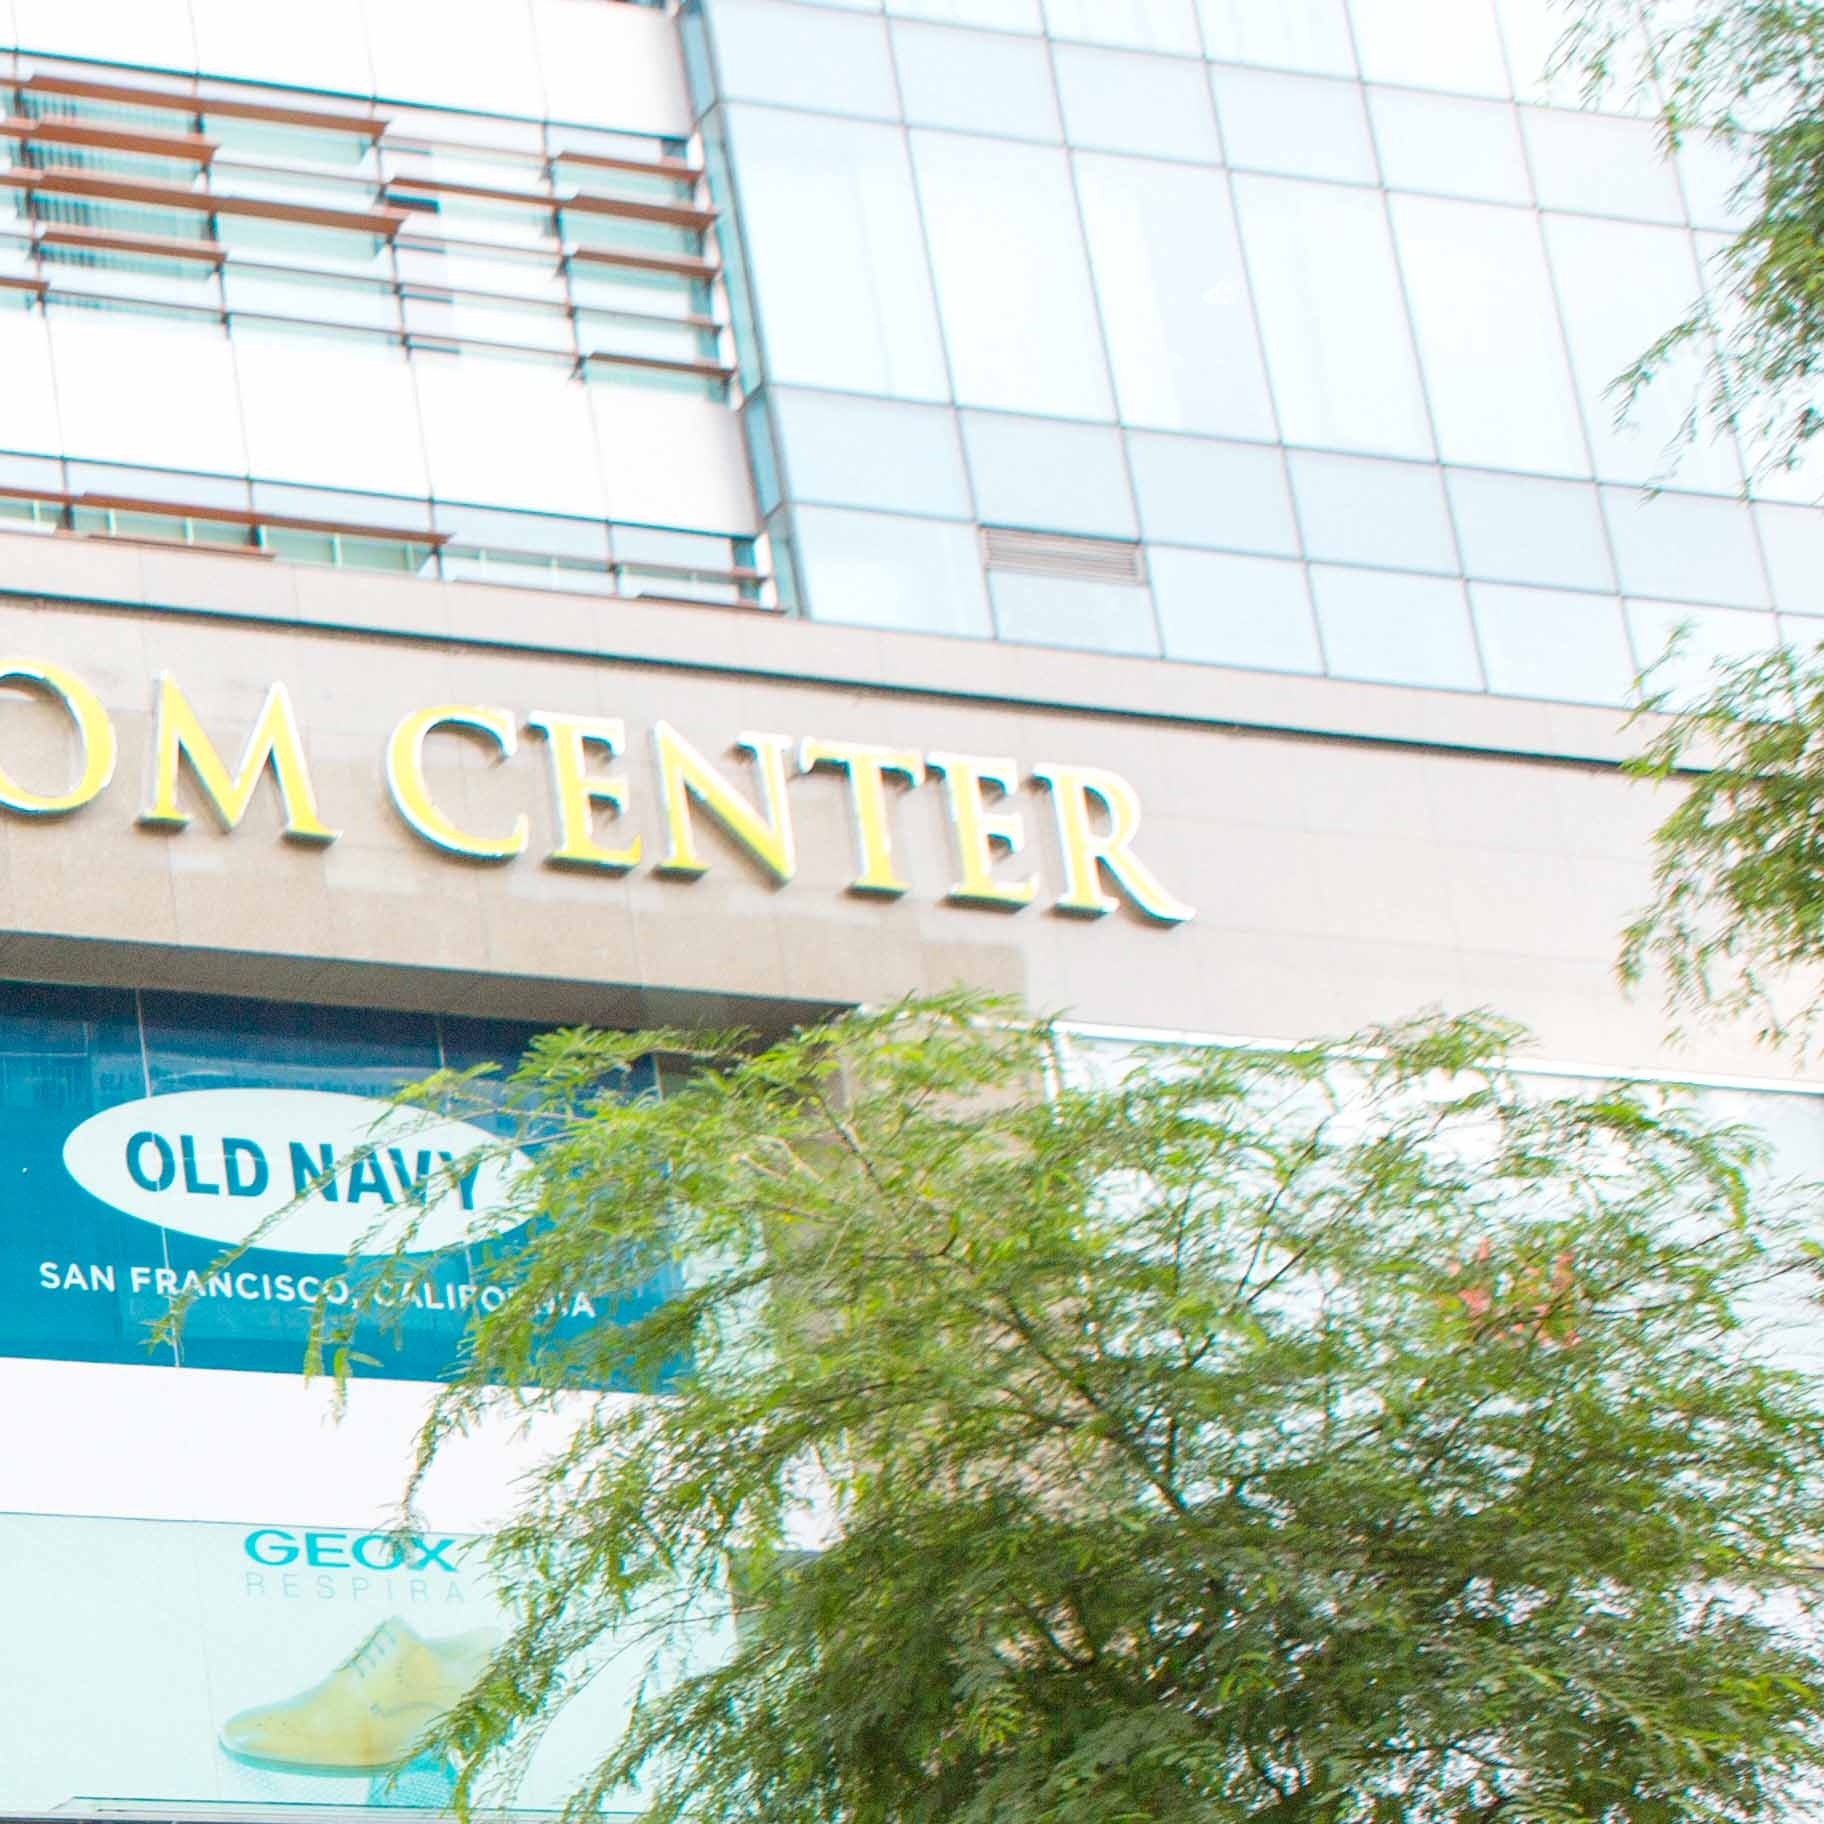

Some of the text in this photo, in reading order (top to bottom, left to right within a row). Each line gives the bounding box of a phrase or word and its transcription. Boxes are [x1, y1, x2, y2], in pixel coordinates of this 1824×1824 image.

[384, 702, 1197, 925] CENTER
[126, 1130, 480, 1211] OLD NAVY
[39, 1260, 116, 1293] SAN
[244, 1528, 459, 1573] GEOX
[245, 1571, 465, 1604] RESPIRA
